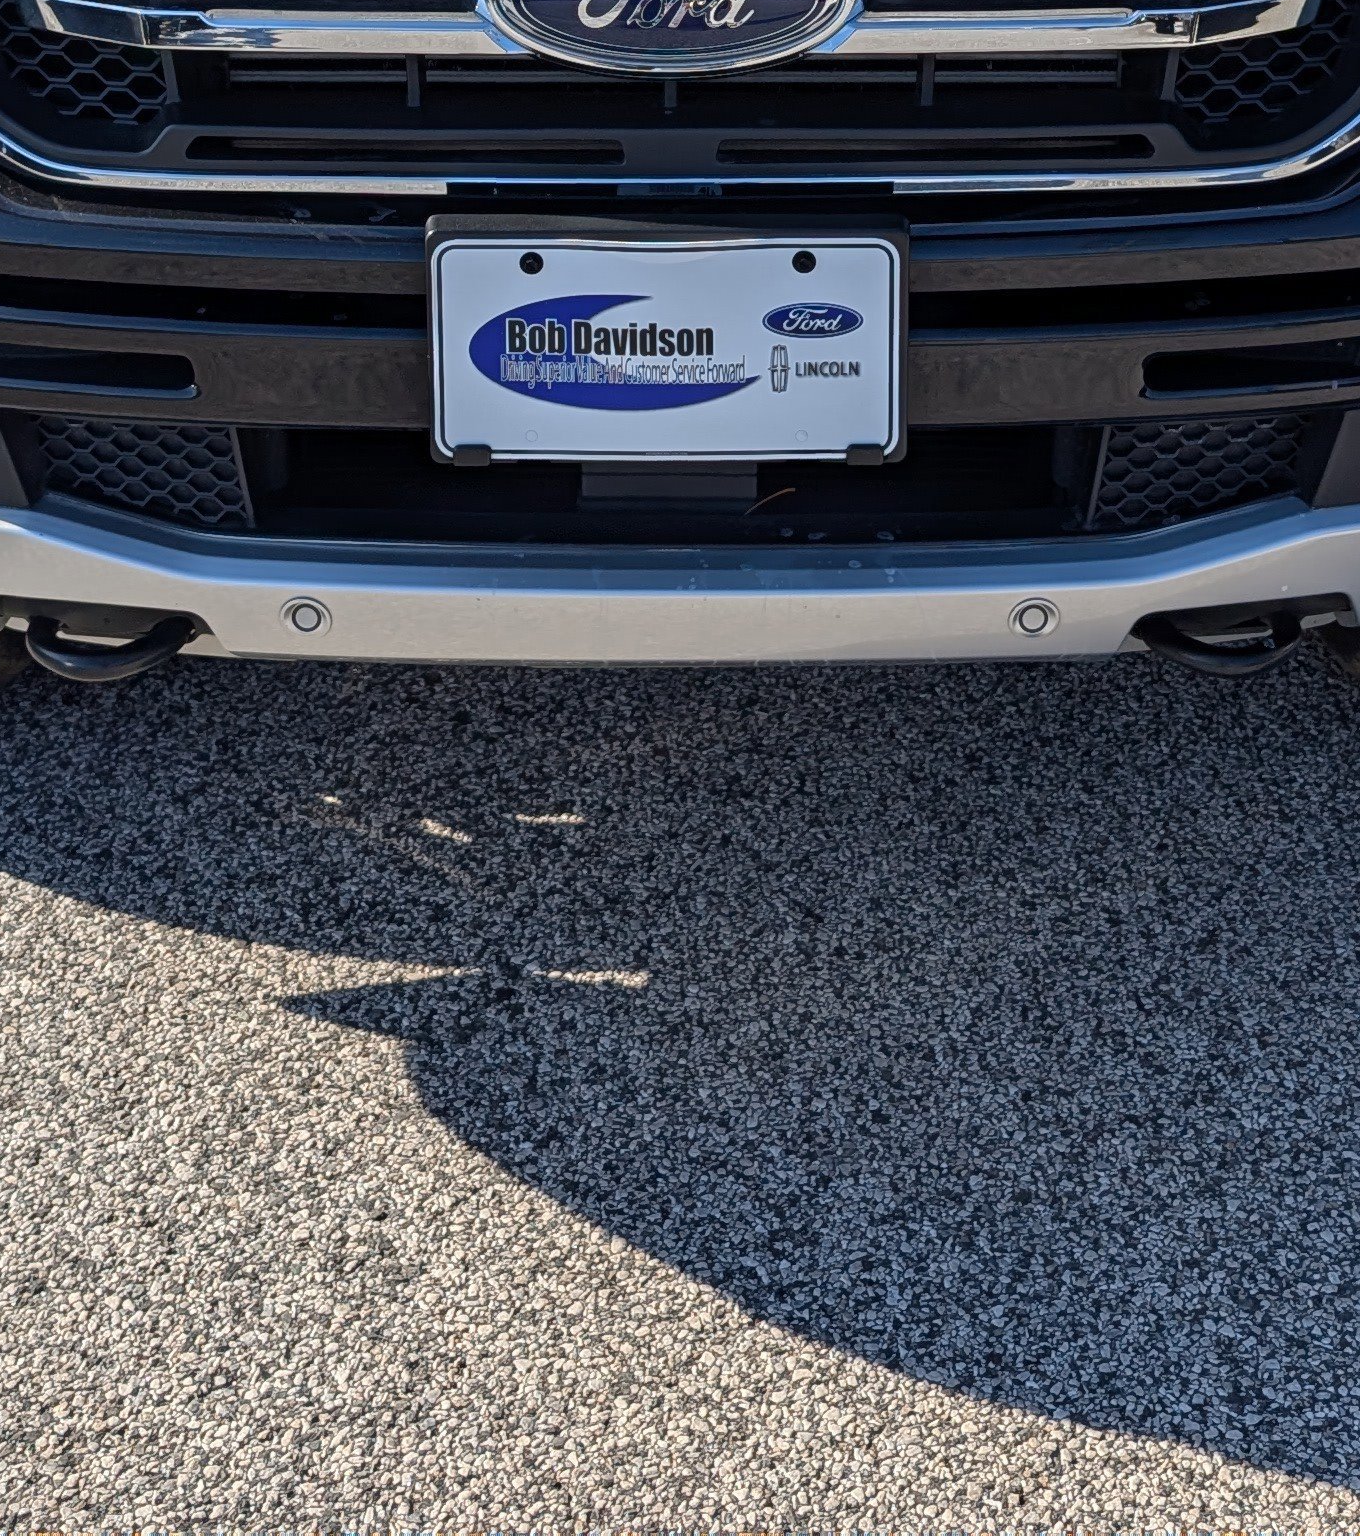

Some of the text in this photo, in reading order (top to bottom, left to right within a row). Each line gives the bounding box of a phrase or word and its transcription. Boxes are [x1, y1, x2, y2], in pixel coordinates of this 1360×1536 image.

[783, 308, 843, 331] Ford
[507, 319, 715, 357] Bob Davidson
[500, 354, 536, 389] Driving
[625, 357, 670, 384] Customer
[671, 358, 705, 384] Service
[707, 354, 746, 384] Forward
[795, 361, 860, 377] LINCOLN
